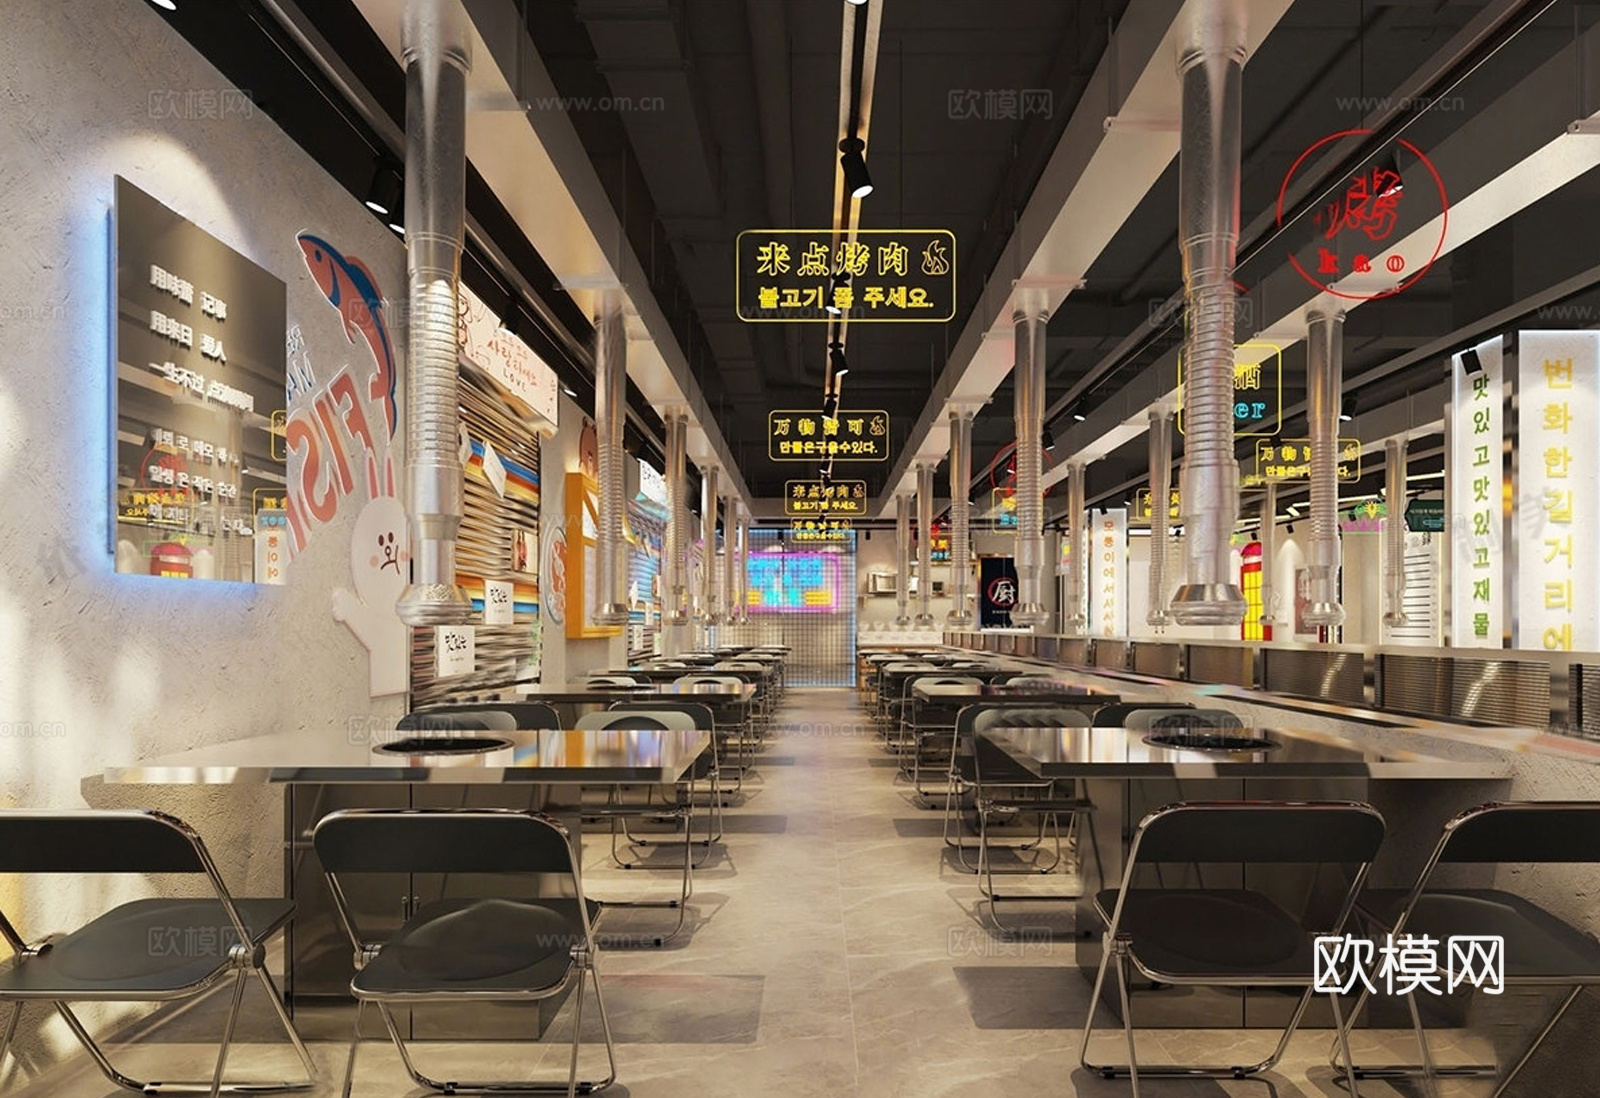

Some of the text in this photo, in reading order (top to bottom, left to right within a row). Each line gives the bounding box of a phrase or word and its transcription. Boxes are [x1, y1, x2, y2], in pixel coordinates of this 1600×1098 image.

[757, 242, 908, 276] 来点烤肉
[758, 286, 823, 309] 불고기
[863, 286, 934, 309] 주세요.
[1233, 402, 1266, 419] er
